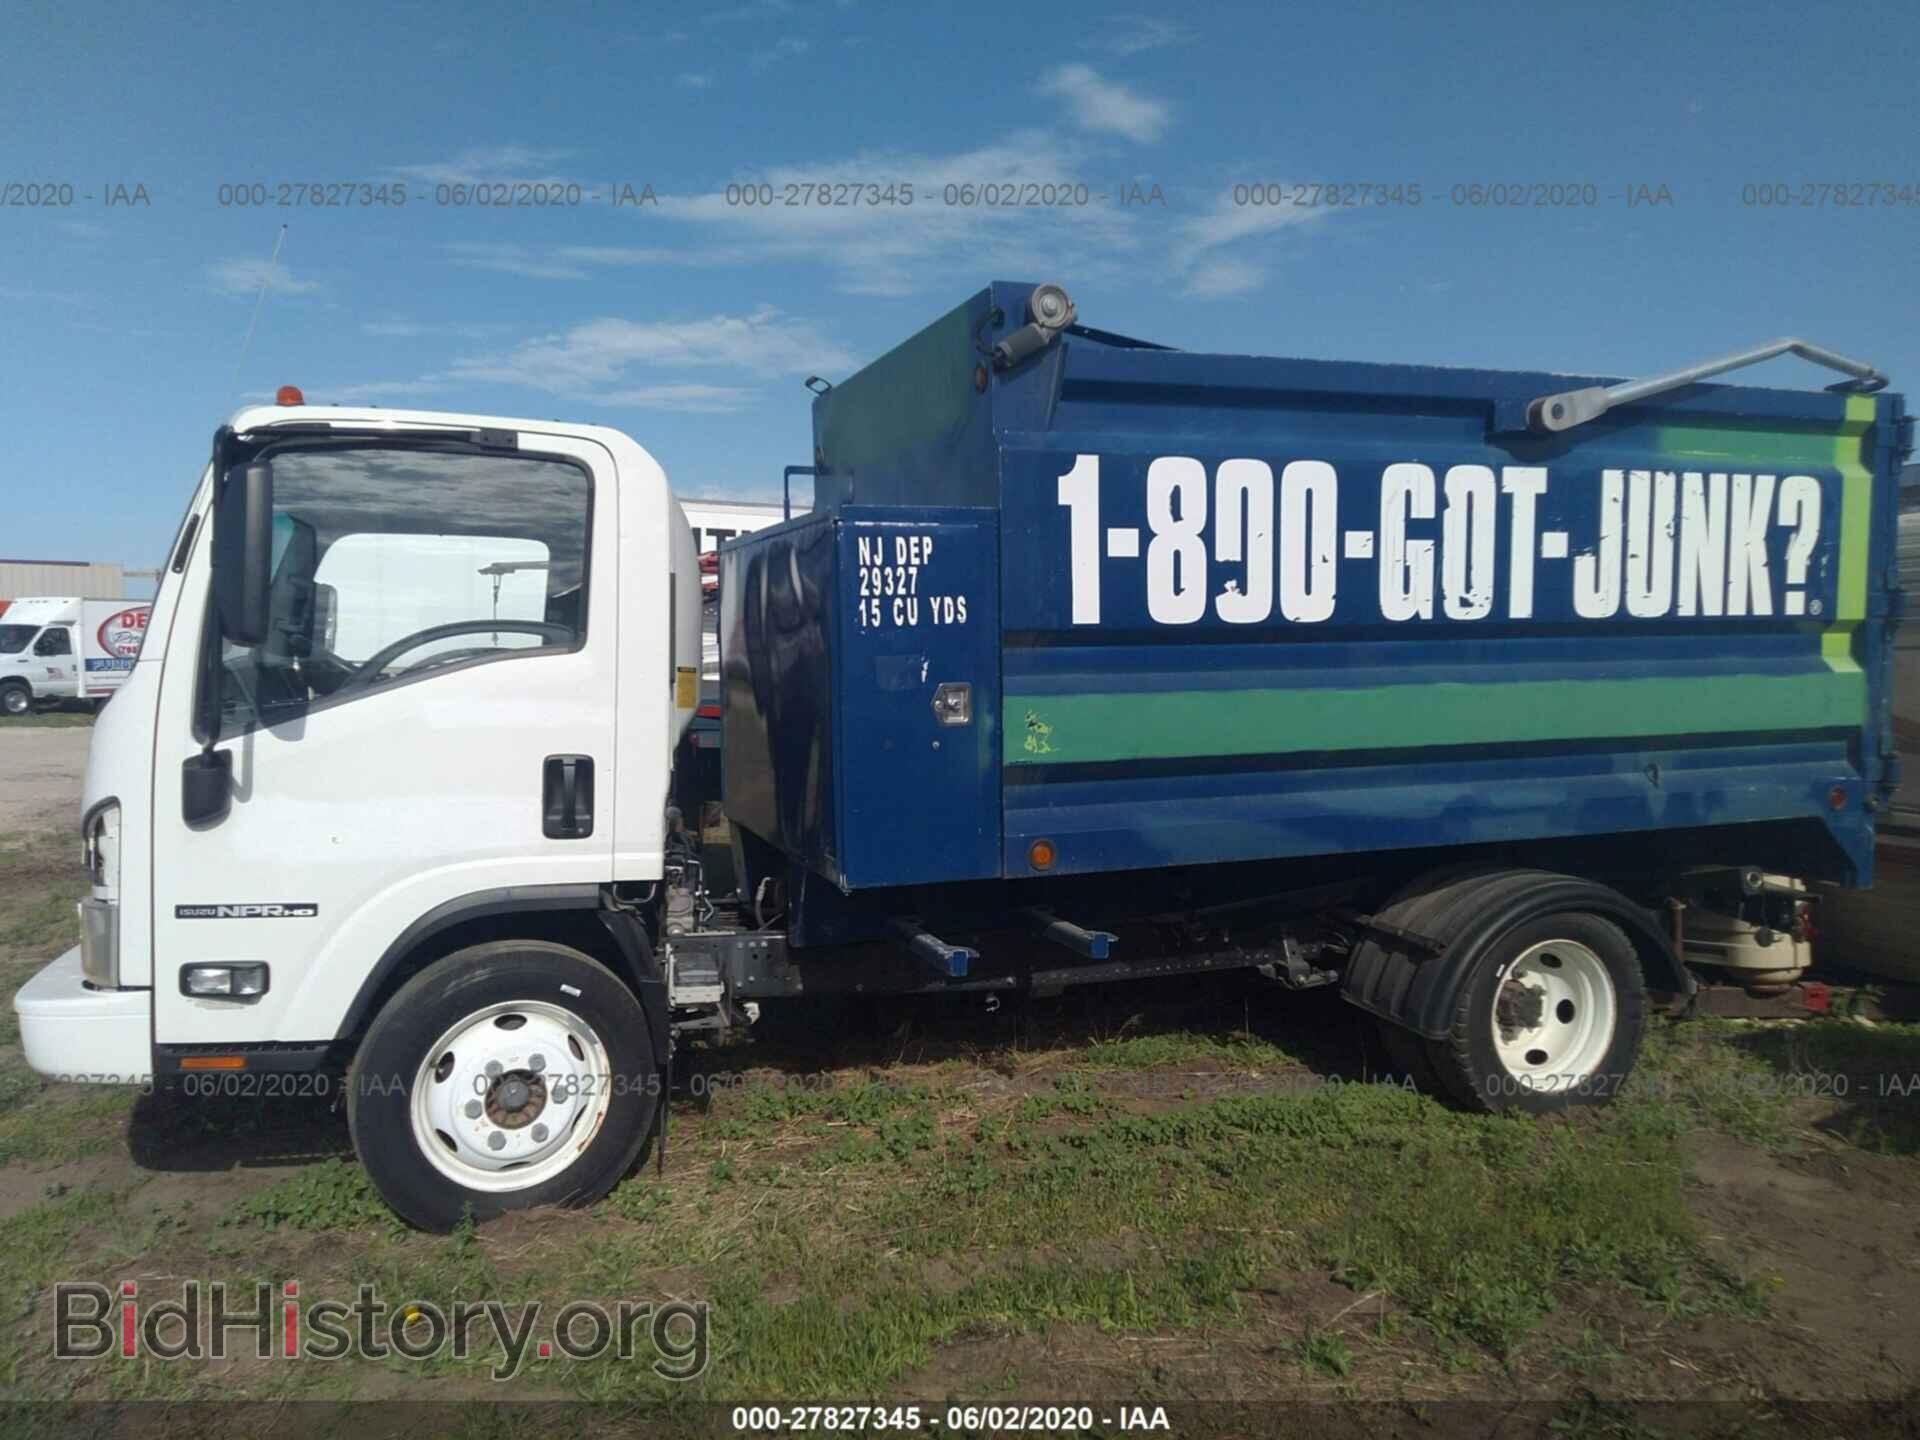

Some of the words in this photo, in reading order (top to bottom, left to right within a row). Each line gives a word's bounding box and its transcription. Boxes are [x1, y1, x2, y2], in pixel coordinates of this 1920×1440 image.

[859, 536, 883, 566] NJ
[896, 536, 933, 565] DEP
[1057, 454, 1822, 625] 1-800-GOT-JUNK?
[860, 566, 918, 596] 29327
[860, 598, 881, 627] 15
[893, 597, 919, 626] CU
[929, 595, 967, 624] YDS
[180, 908, 216, 917] ISUZU
